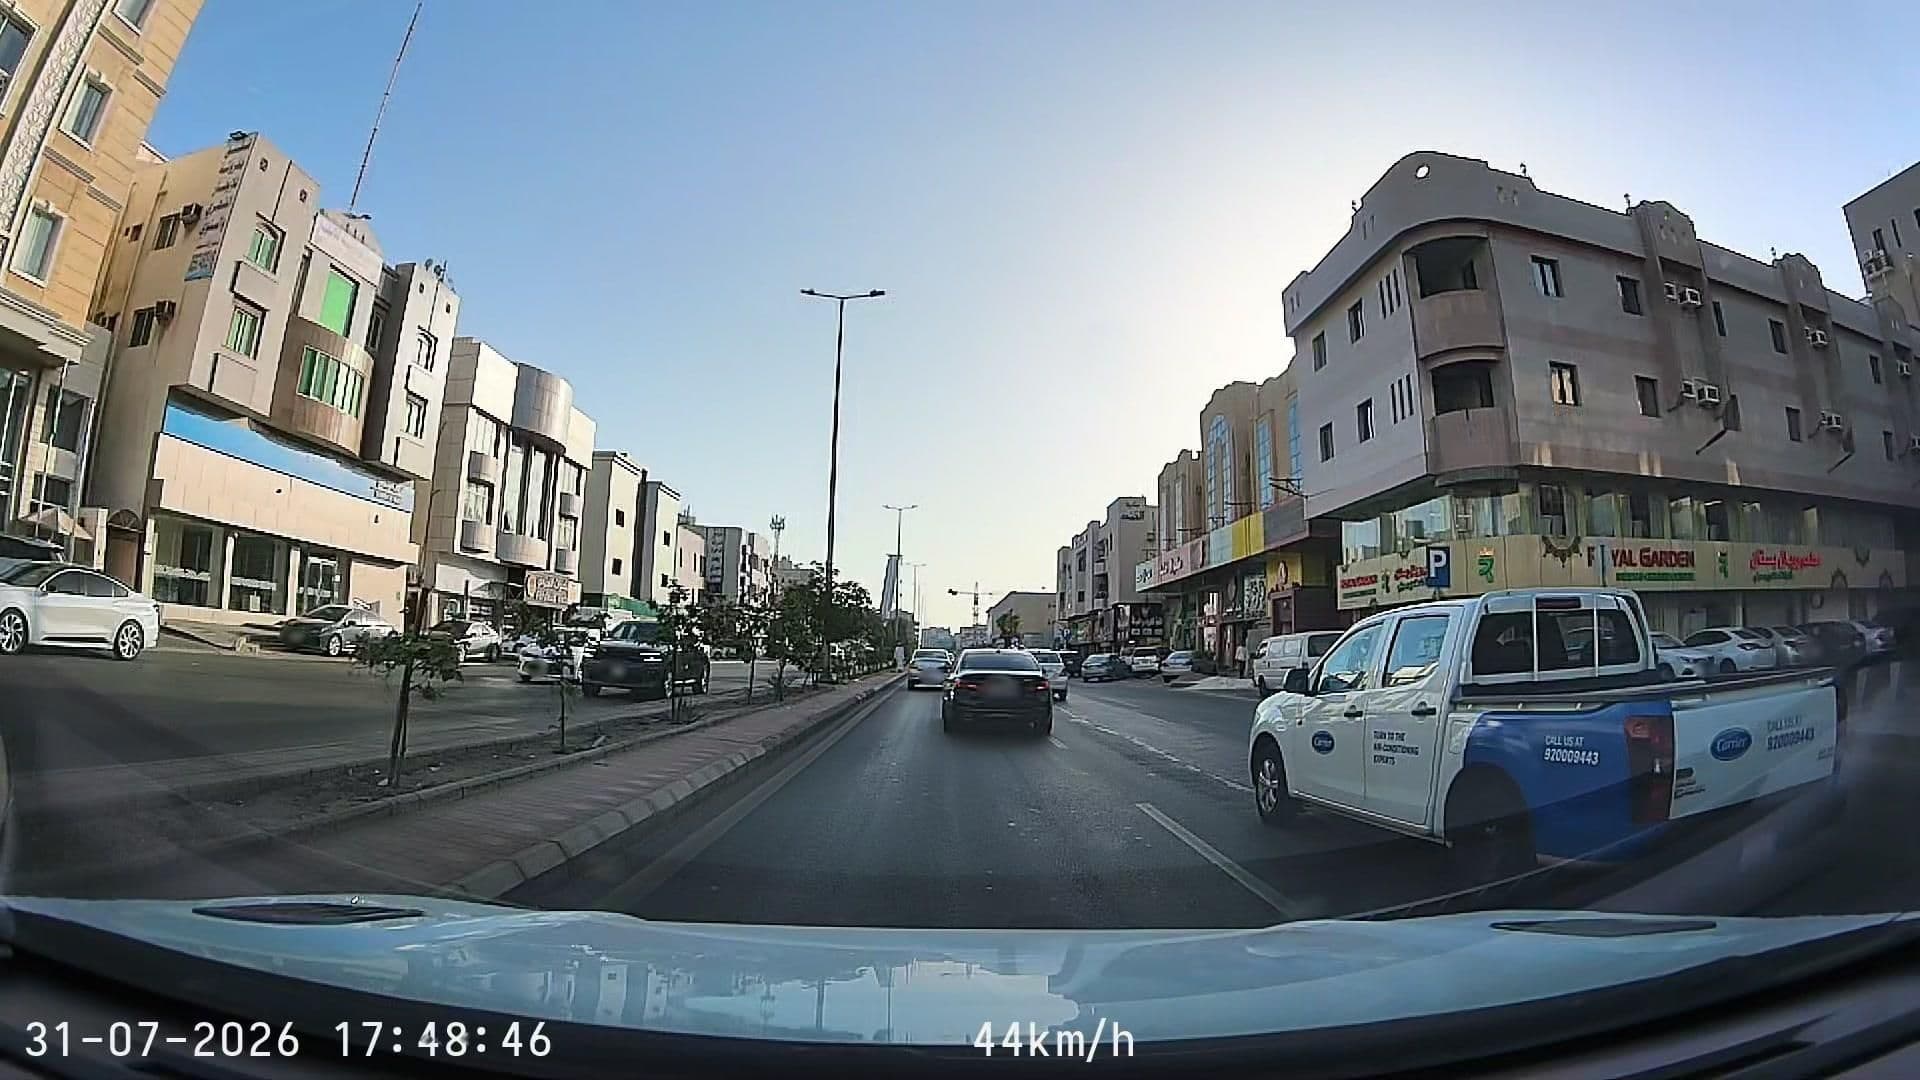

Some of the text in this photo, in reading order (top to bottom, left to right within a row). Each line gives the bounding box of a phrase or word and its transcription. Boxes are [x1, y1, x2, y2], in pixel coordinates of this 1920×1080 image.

[1429, 550, 1447, 577] P
[1640, 547, 1695, 568] GARDEN
[1545, 735, 1584, 748] CALL US AT
[1544, 747, 1599, 766] 920009443
